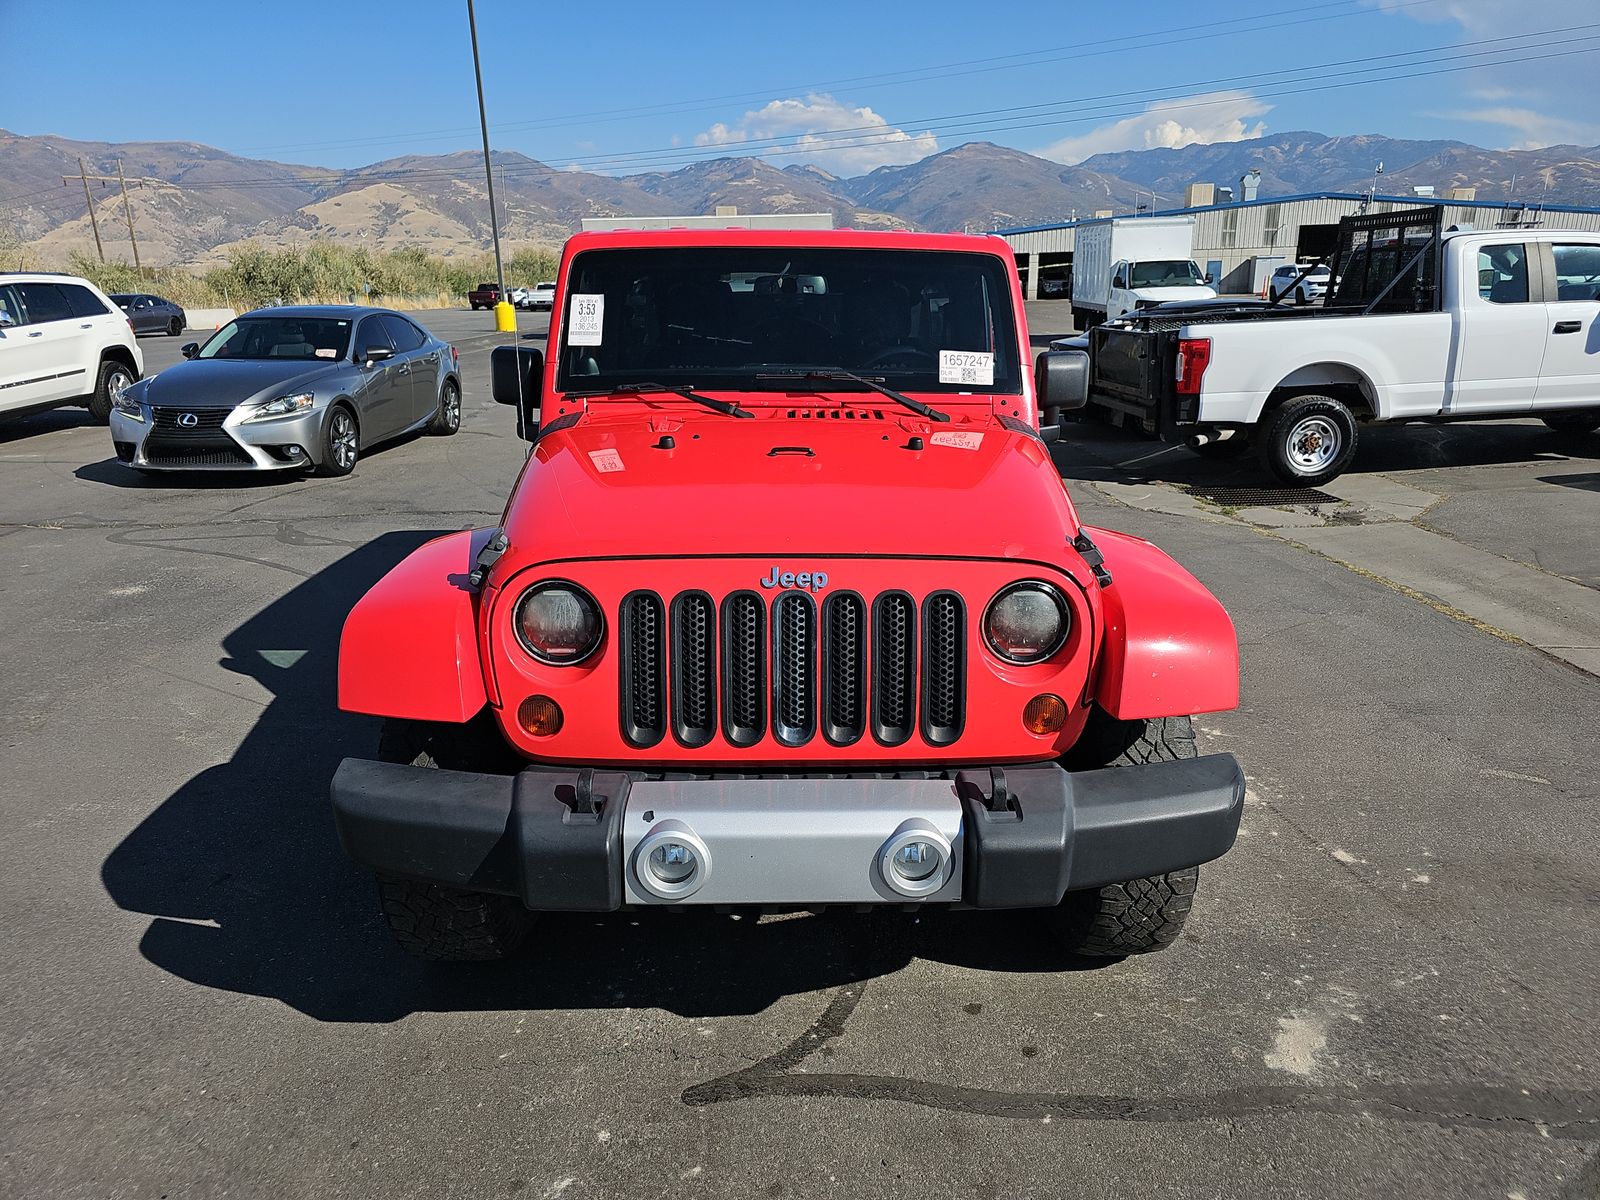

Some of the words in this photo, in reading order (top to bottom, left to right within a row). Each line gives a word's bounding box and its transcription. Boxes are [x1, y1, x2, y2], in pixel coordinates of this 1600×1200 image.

[578, 304, 595, 315] 3:53
[576, 322, 598, 331] 136,245
[944, 354, 990, 367] 1657247
[760, 566, 828, 593] Jeep
